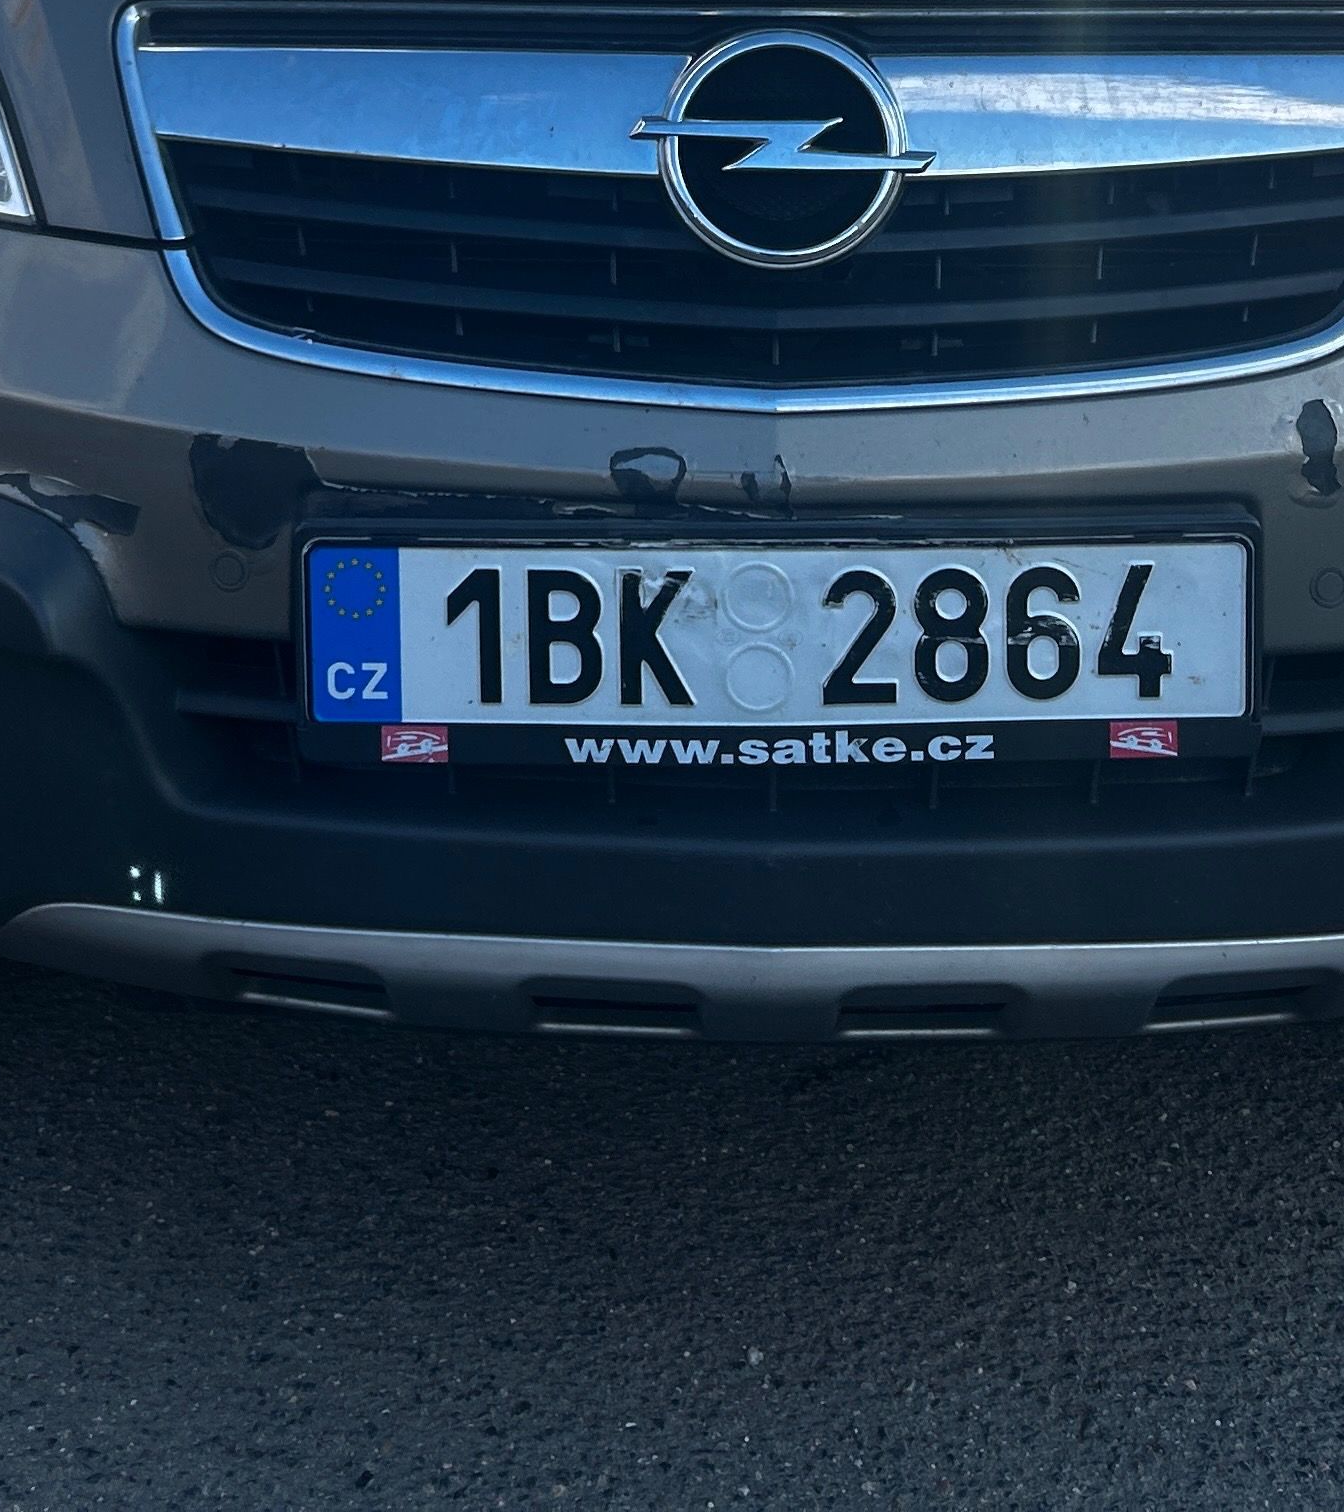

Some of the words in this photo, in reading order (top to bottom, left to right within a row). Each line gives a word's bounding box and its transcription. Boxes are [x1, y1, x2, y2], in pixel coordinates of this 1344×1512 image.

[446, 567, 697, 706] 1BK
[821, 561, 1174, 706] 2864
[327, 661, 389, 700] CZ
[564, 729, 995, 765] www.satke.cz
